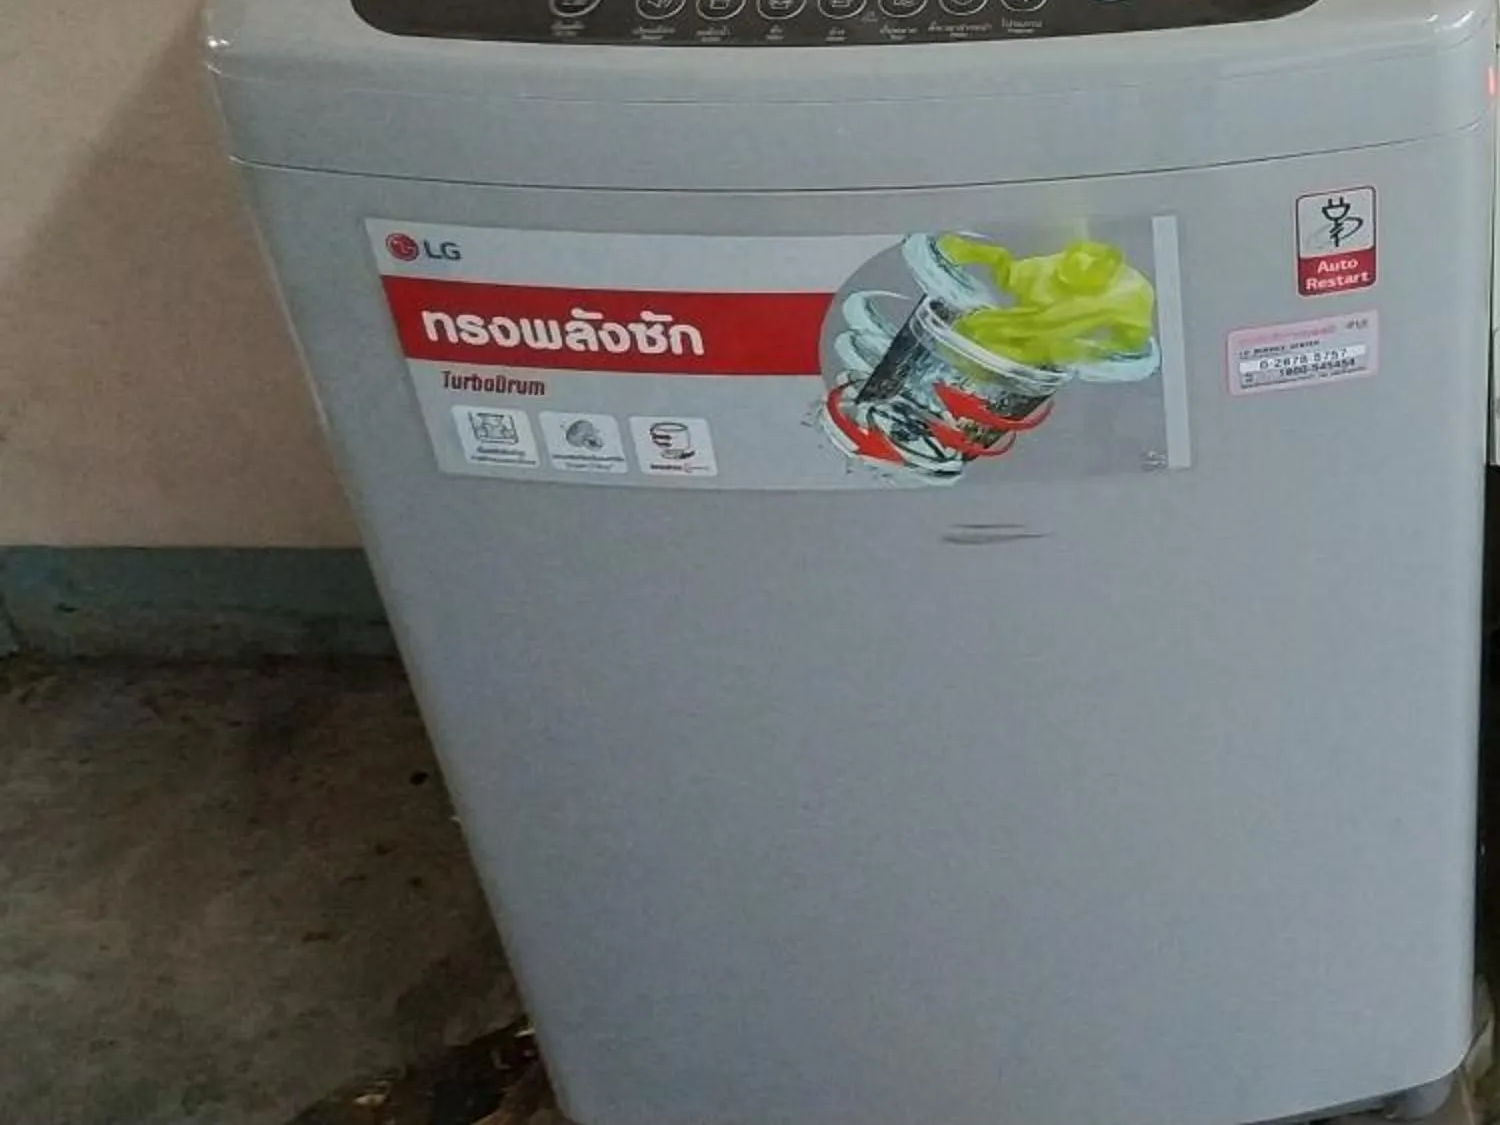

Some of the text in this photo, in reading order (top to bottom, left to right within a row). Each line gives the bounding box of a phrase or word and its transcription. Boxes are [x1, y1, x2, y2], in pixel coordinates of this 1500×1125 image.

[423, 240, 462, 261] LG
[1317, 257, 1359, 274] Auto
[1305, 271, 1370, 291] Restart
[421, 308, 705, 356] ทรงพลังซัก
[441, 371, 546, 396] TurboDrum
